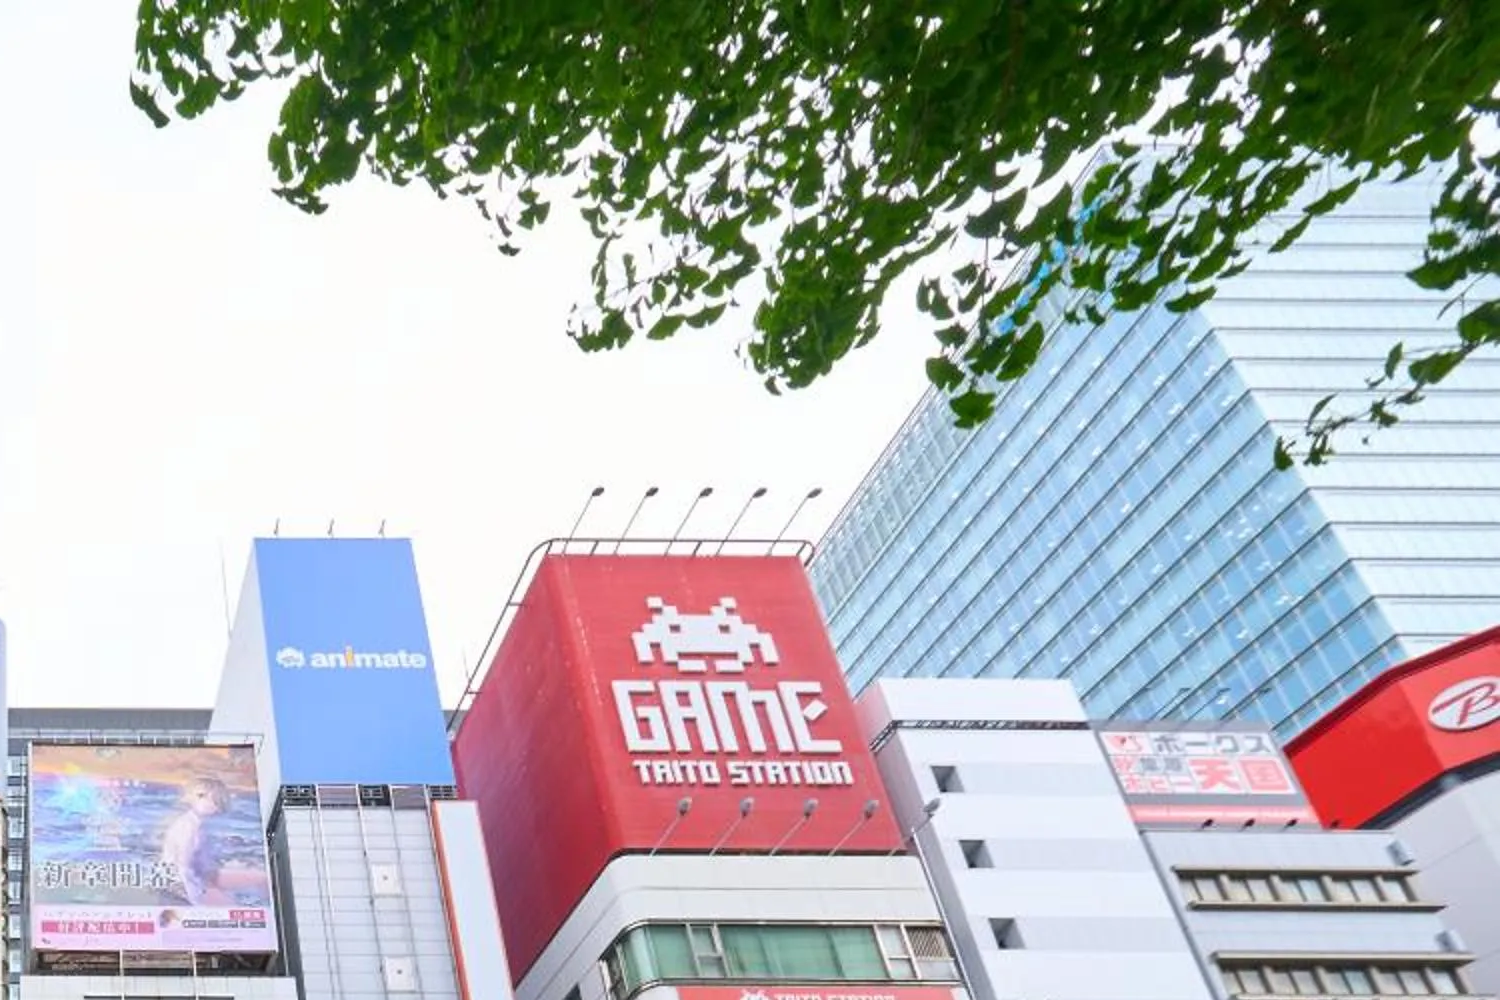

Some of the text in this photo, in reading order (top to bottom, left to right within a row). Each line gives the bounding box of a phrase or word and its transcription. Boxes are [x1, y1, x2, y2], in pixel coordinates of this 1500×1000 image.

[311, 645, 427, 668] animate
[611, 680, 843, 754] GAME
[633, 760, 855, 785] TAITO STATION
